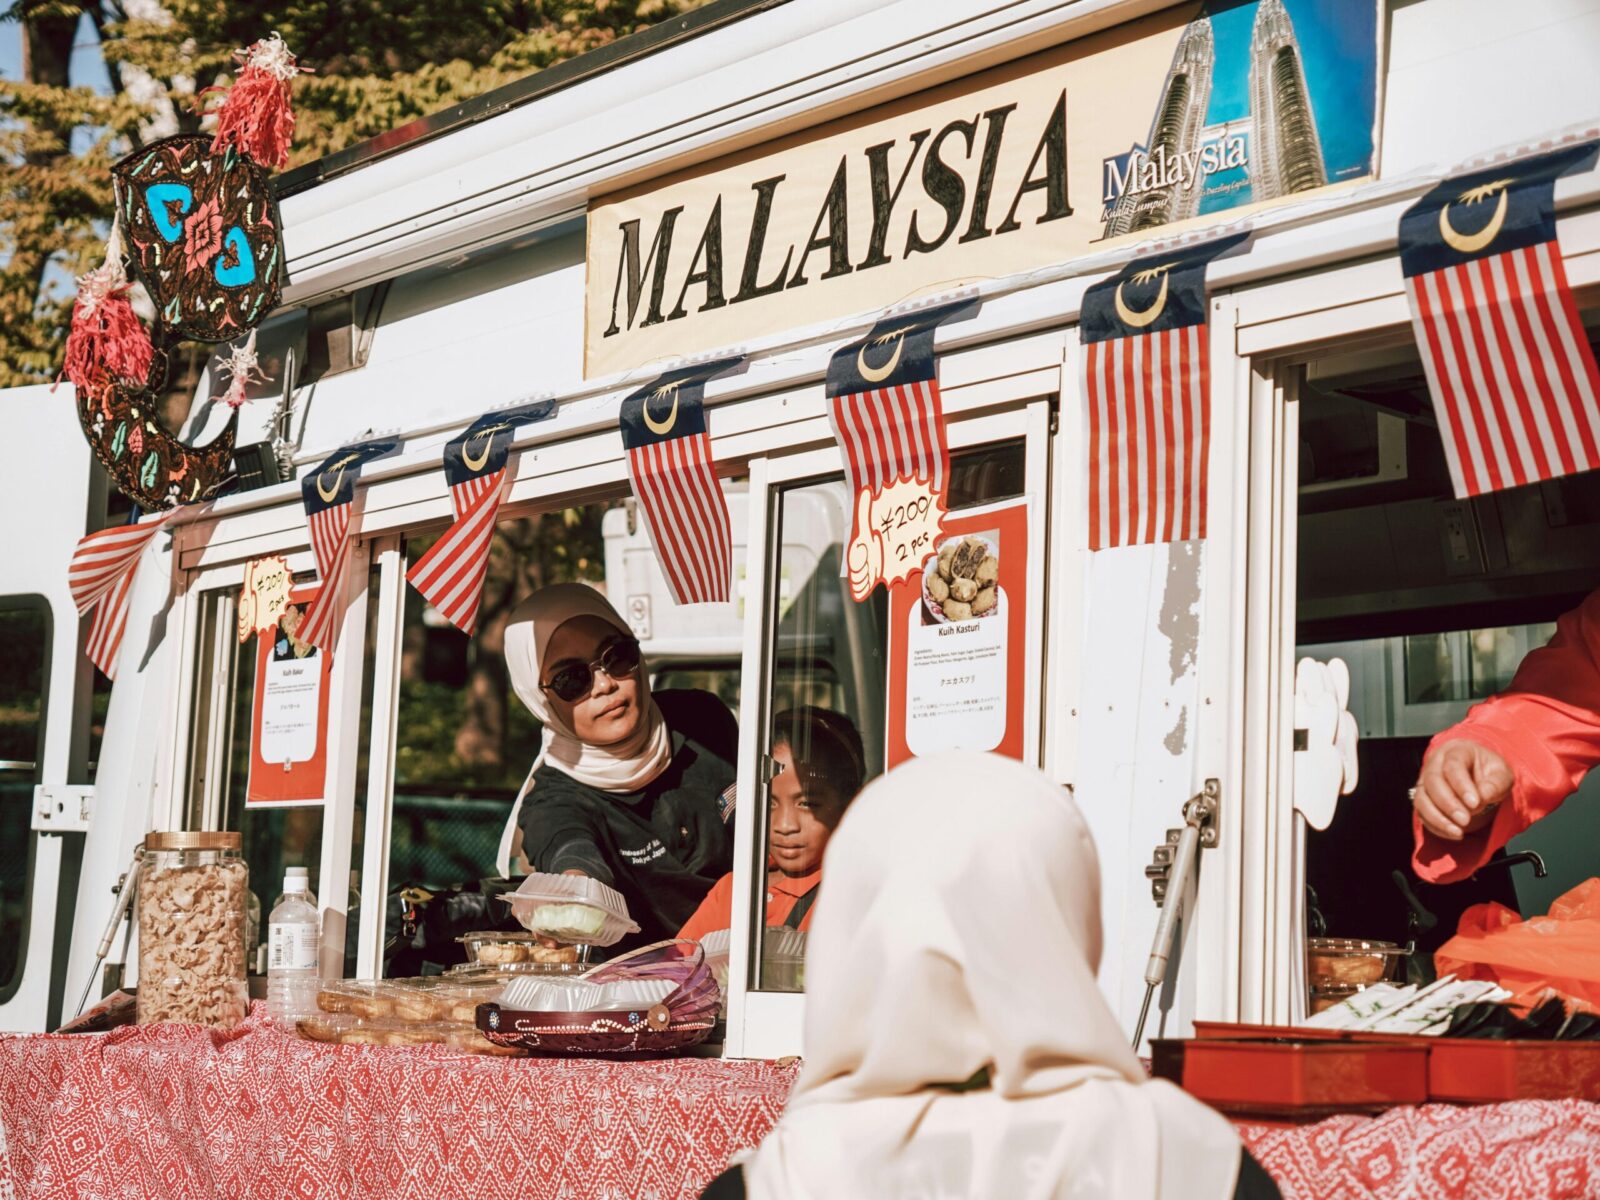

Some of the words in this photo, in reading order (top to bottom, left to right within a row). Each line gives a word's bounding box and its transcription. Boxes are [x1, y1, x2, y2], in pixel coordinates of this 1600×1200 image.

[1103, 122, 1248, 201] Malaysia
[603, 87, 1074, 338] MALAYSIA
[1102, 203, 1129, 220] Kuala
[1131, 198, 1168, 215] Lumpur
[895, 543, 908, 561] 2
[911, 532, 929, 556] pcs
[938, 626, 954, 637] Kuih
[956, 622, 980, 634] Kasturi
